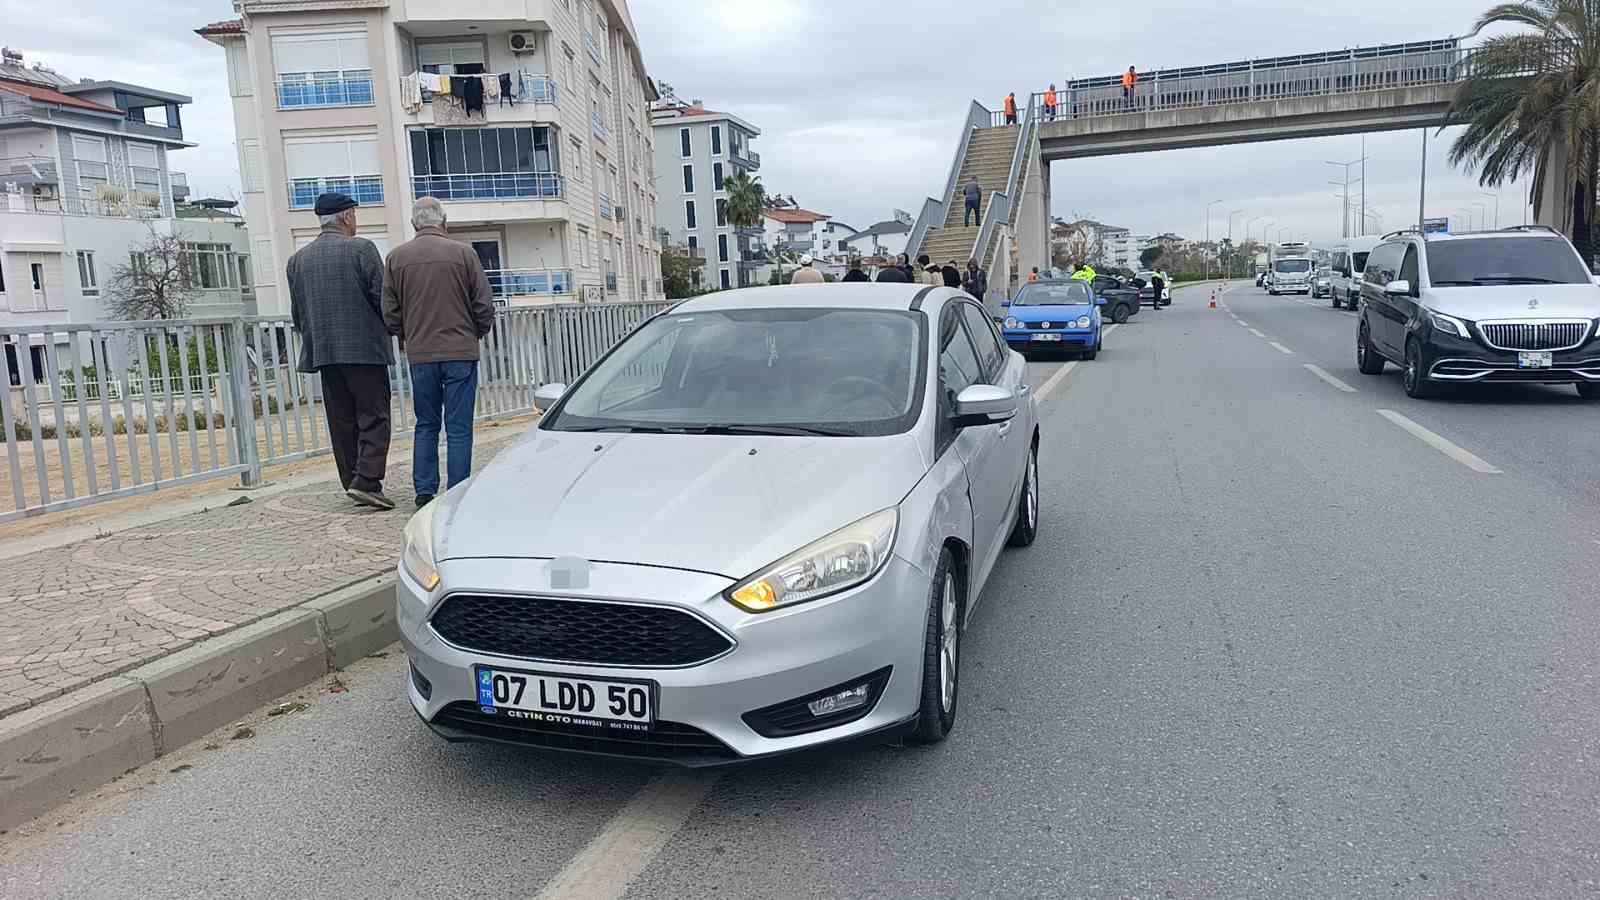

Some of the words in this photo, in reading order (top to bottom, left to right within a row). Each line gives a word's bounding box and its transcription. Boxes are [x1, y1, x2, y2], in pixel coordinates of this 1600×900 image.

[480, 689, 492, 698] TR
[493, 674, 527, 705] 07
[539, 679, 596, 713] LDD
[607, 685, 648, 718] 50
[546, 714, 571, 723] OTO
